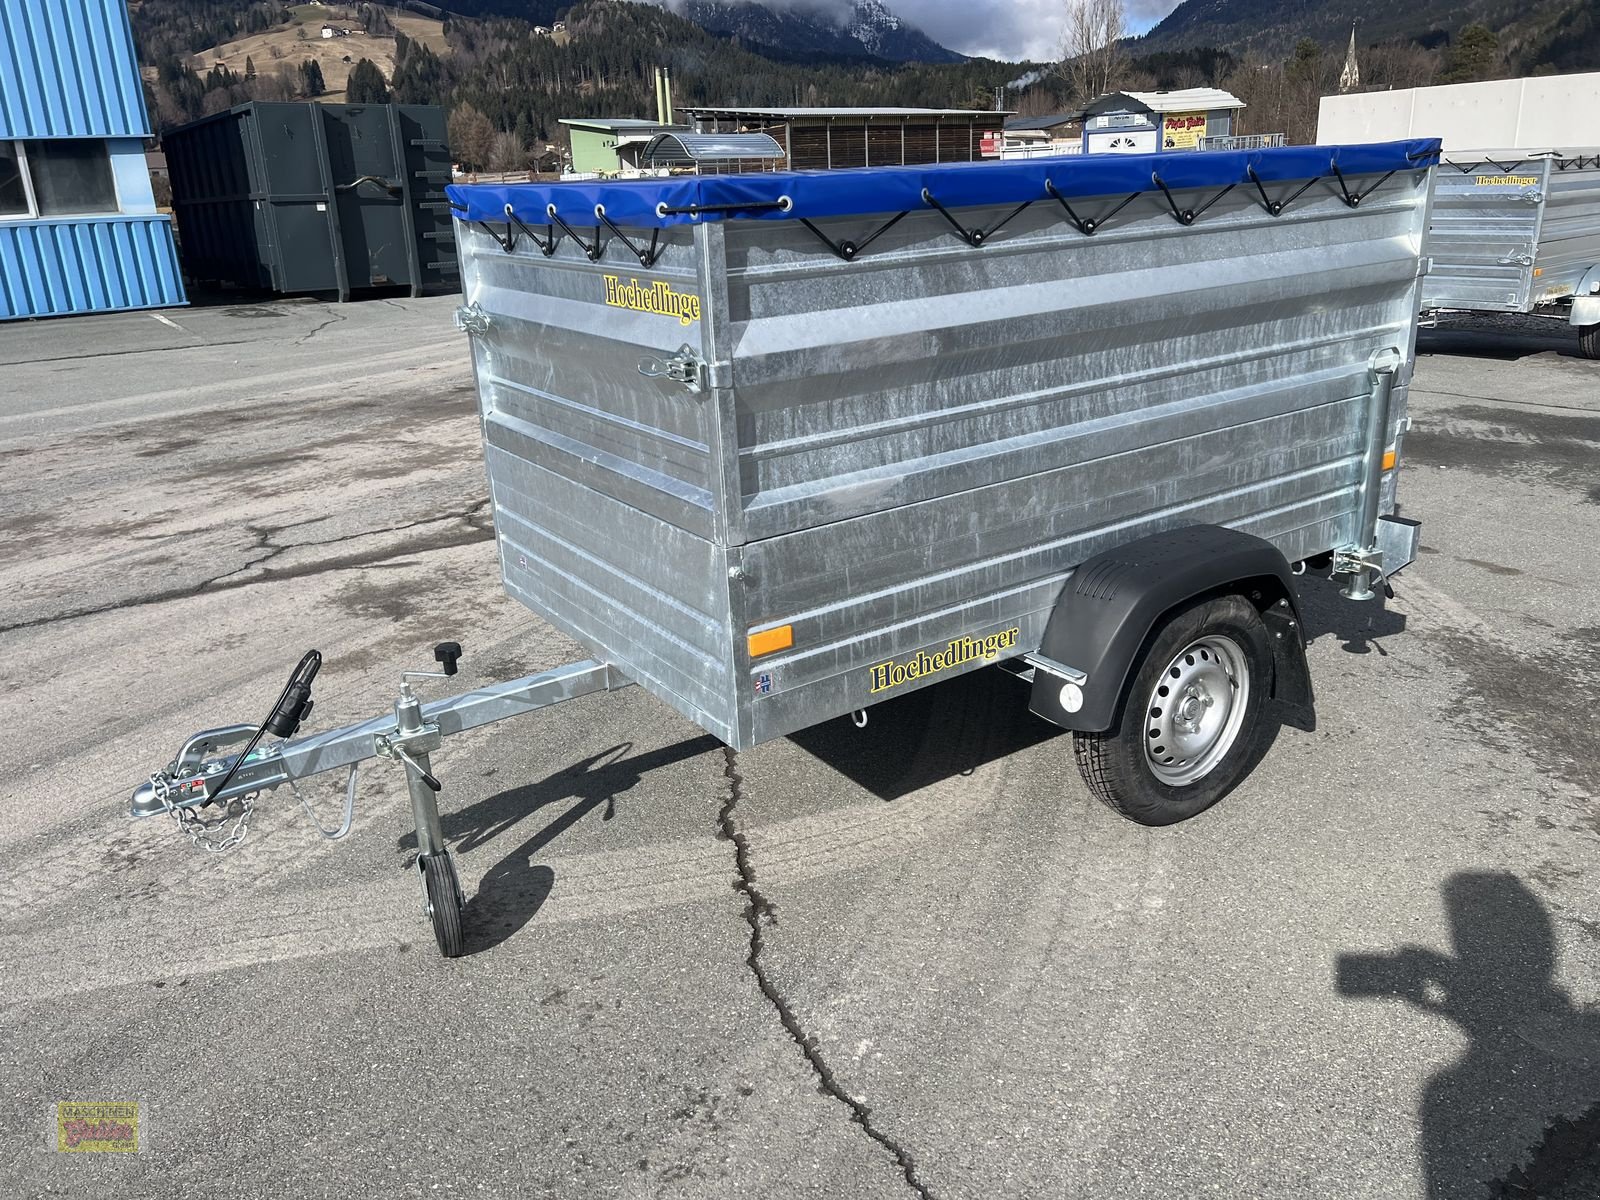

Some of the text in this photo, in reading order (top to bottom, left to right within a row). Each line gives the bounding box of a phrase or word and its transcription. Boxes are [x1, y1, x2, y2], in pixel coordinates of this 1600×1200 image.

[1476, 176, 1538, 187] Hochedlinger
[603, 275, 700, 325] Hochedlinge
[870, 627, 1019, 693] Hochedlinger
